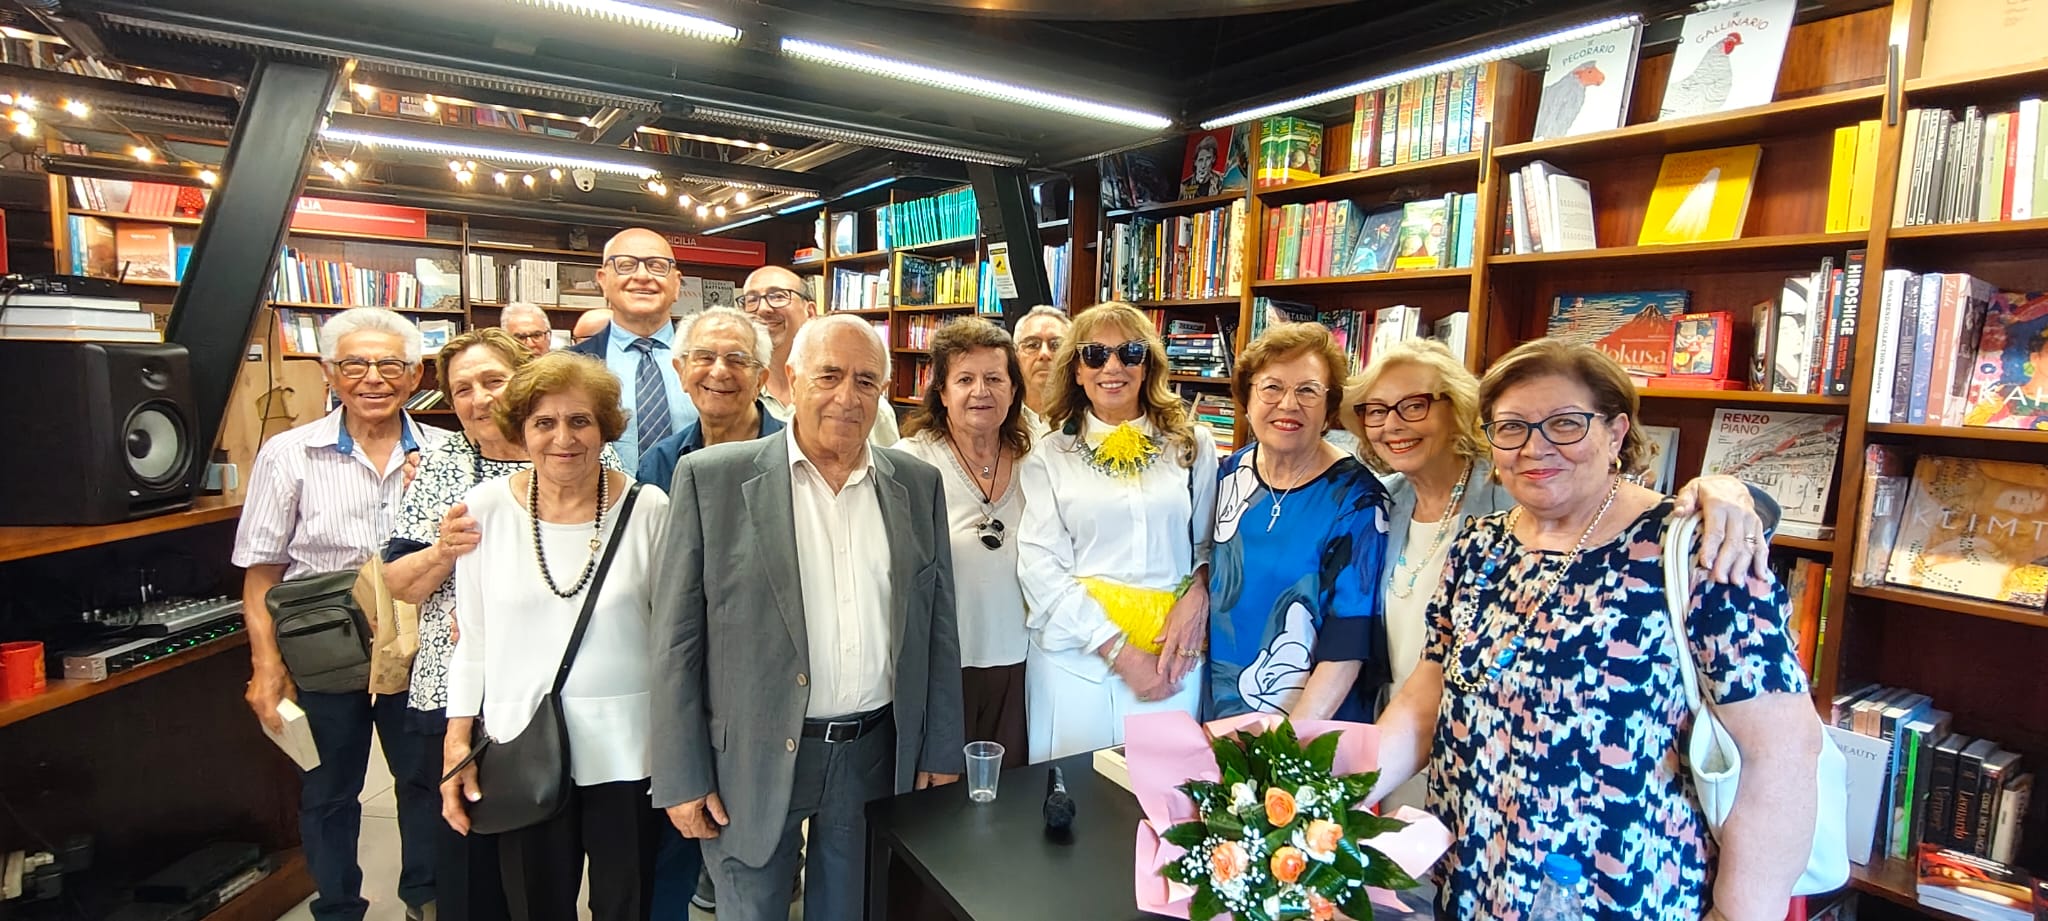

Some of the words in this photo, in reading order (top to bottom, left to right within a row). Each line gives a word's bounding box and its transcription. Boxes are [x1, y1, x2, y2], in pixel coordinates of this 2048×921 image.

[1696, 17, 1769, 43] GALLINARIO
[1562, 45, 1616, 66] PECORARIO
[1840, 264, 1863, 336] HIROSHIGE
[1593, 342, 1666, 365] okusa
[1720, 423, 1760, 435] PIANO
[1722, 412, 1770, 425] RENZO
[1914, 506, 2048, 541] KLIMT
